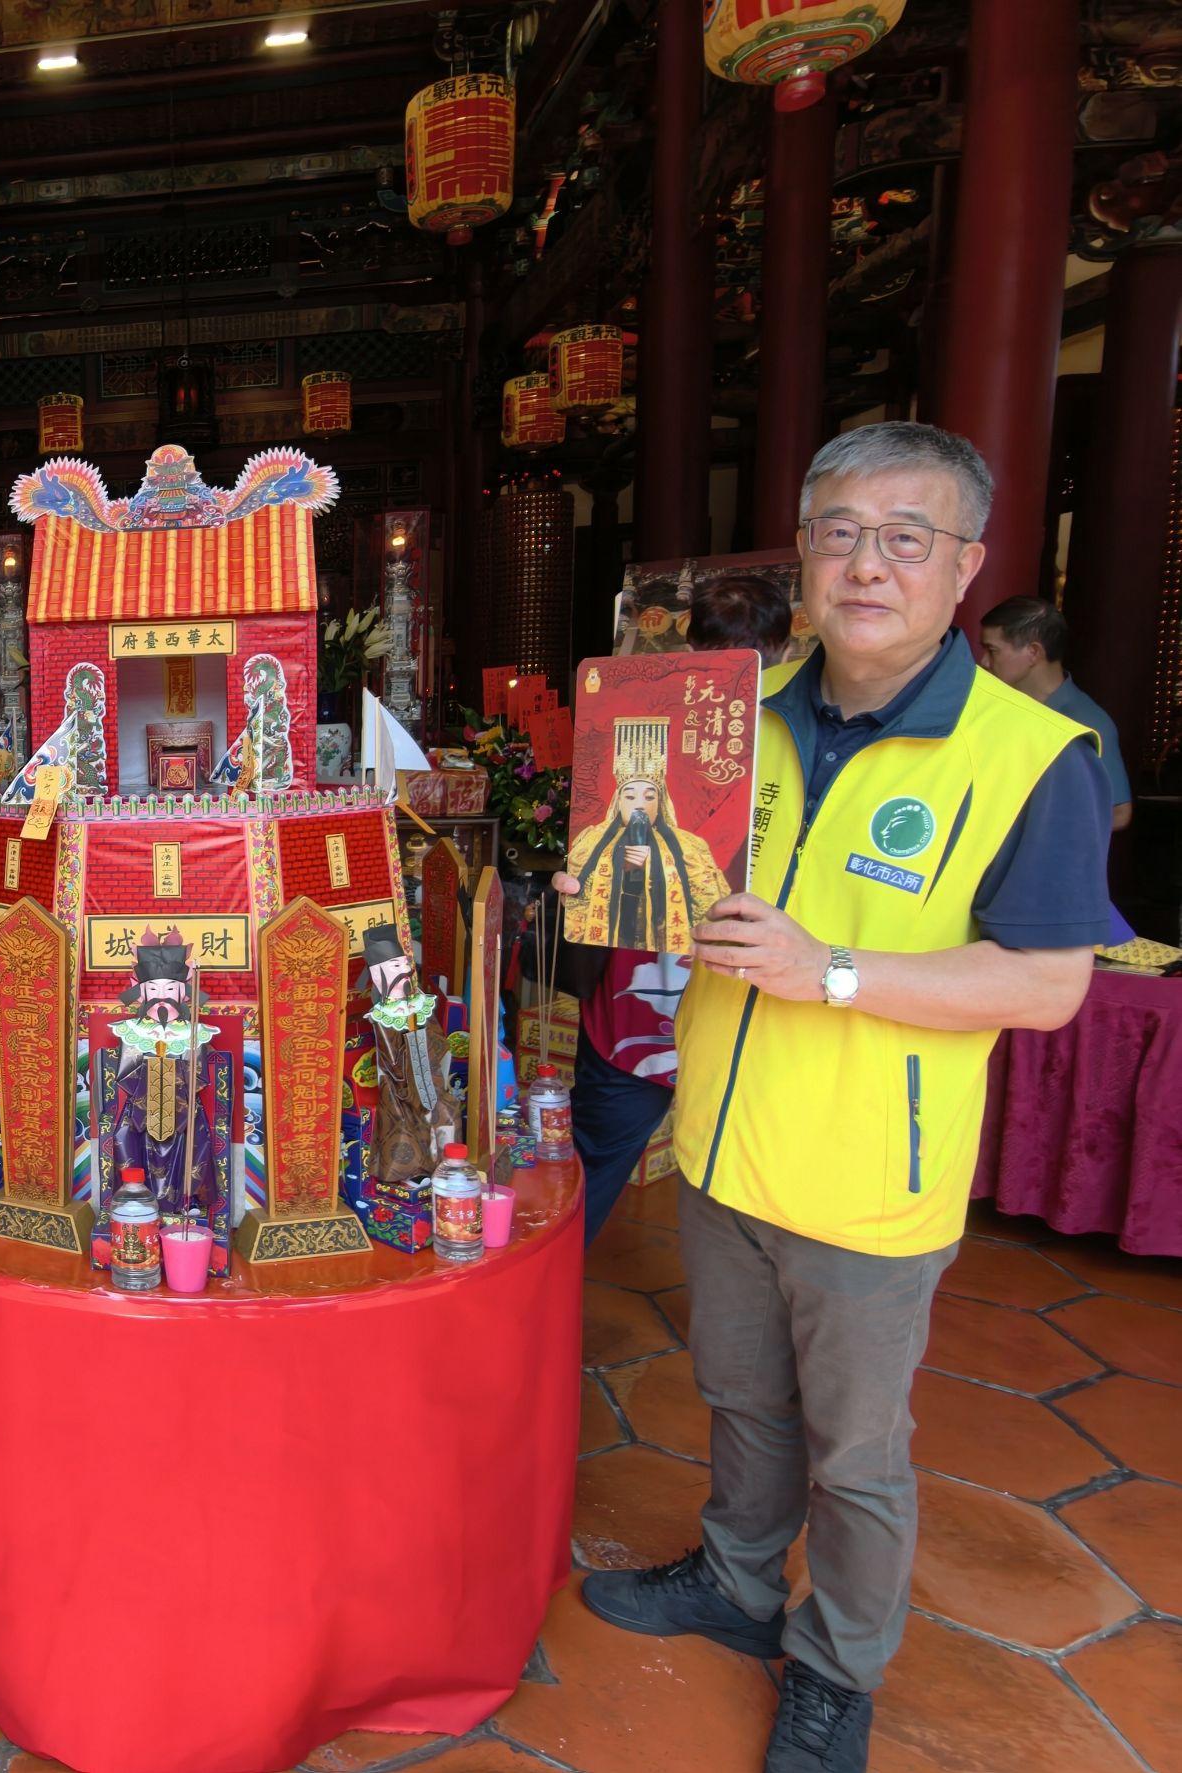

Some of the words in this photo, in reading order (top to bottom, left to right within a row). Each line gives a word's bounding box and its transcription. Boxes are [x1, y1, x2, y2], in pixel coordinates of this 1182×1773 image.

[697, 679, 726, 765] 元清觀
[727, 701, 745, 753] 天公壇
[849, 855, 921, 891] 彰化市公所
